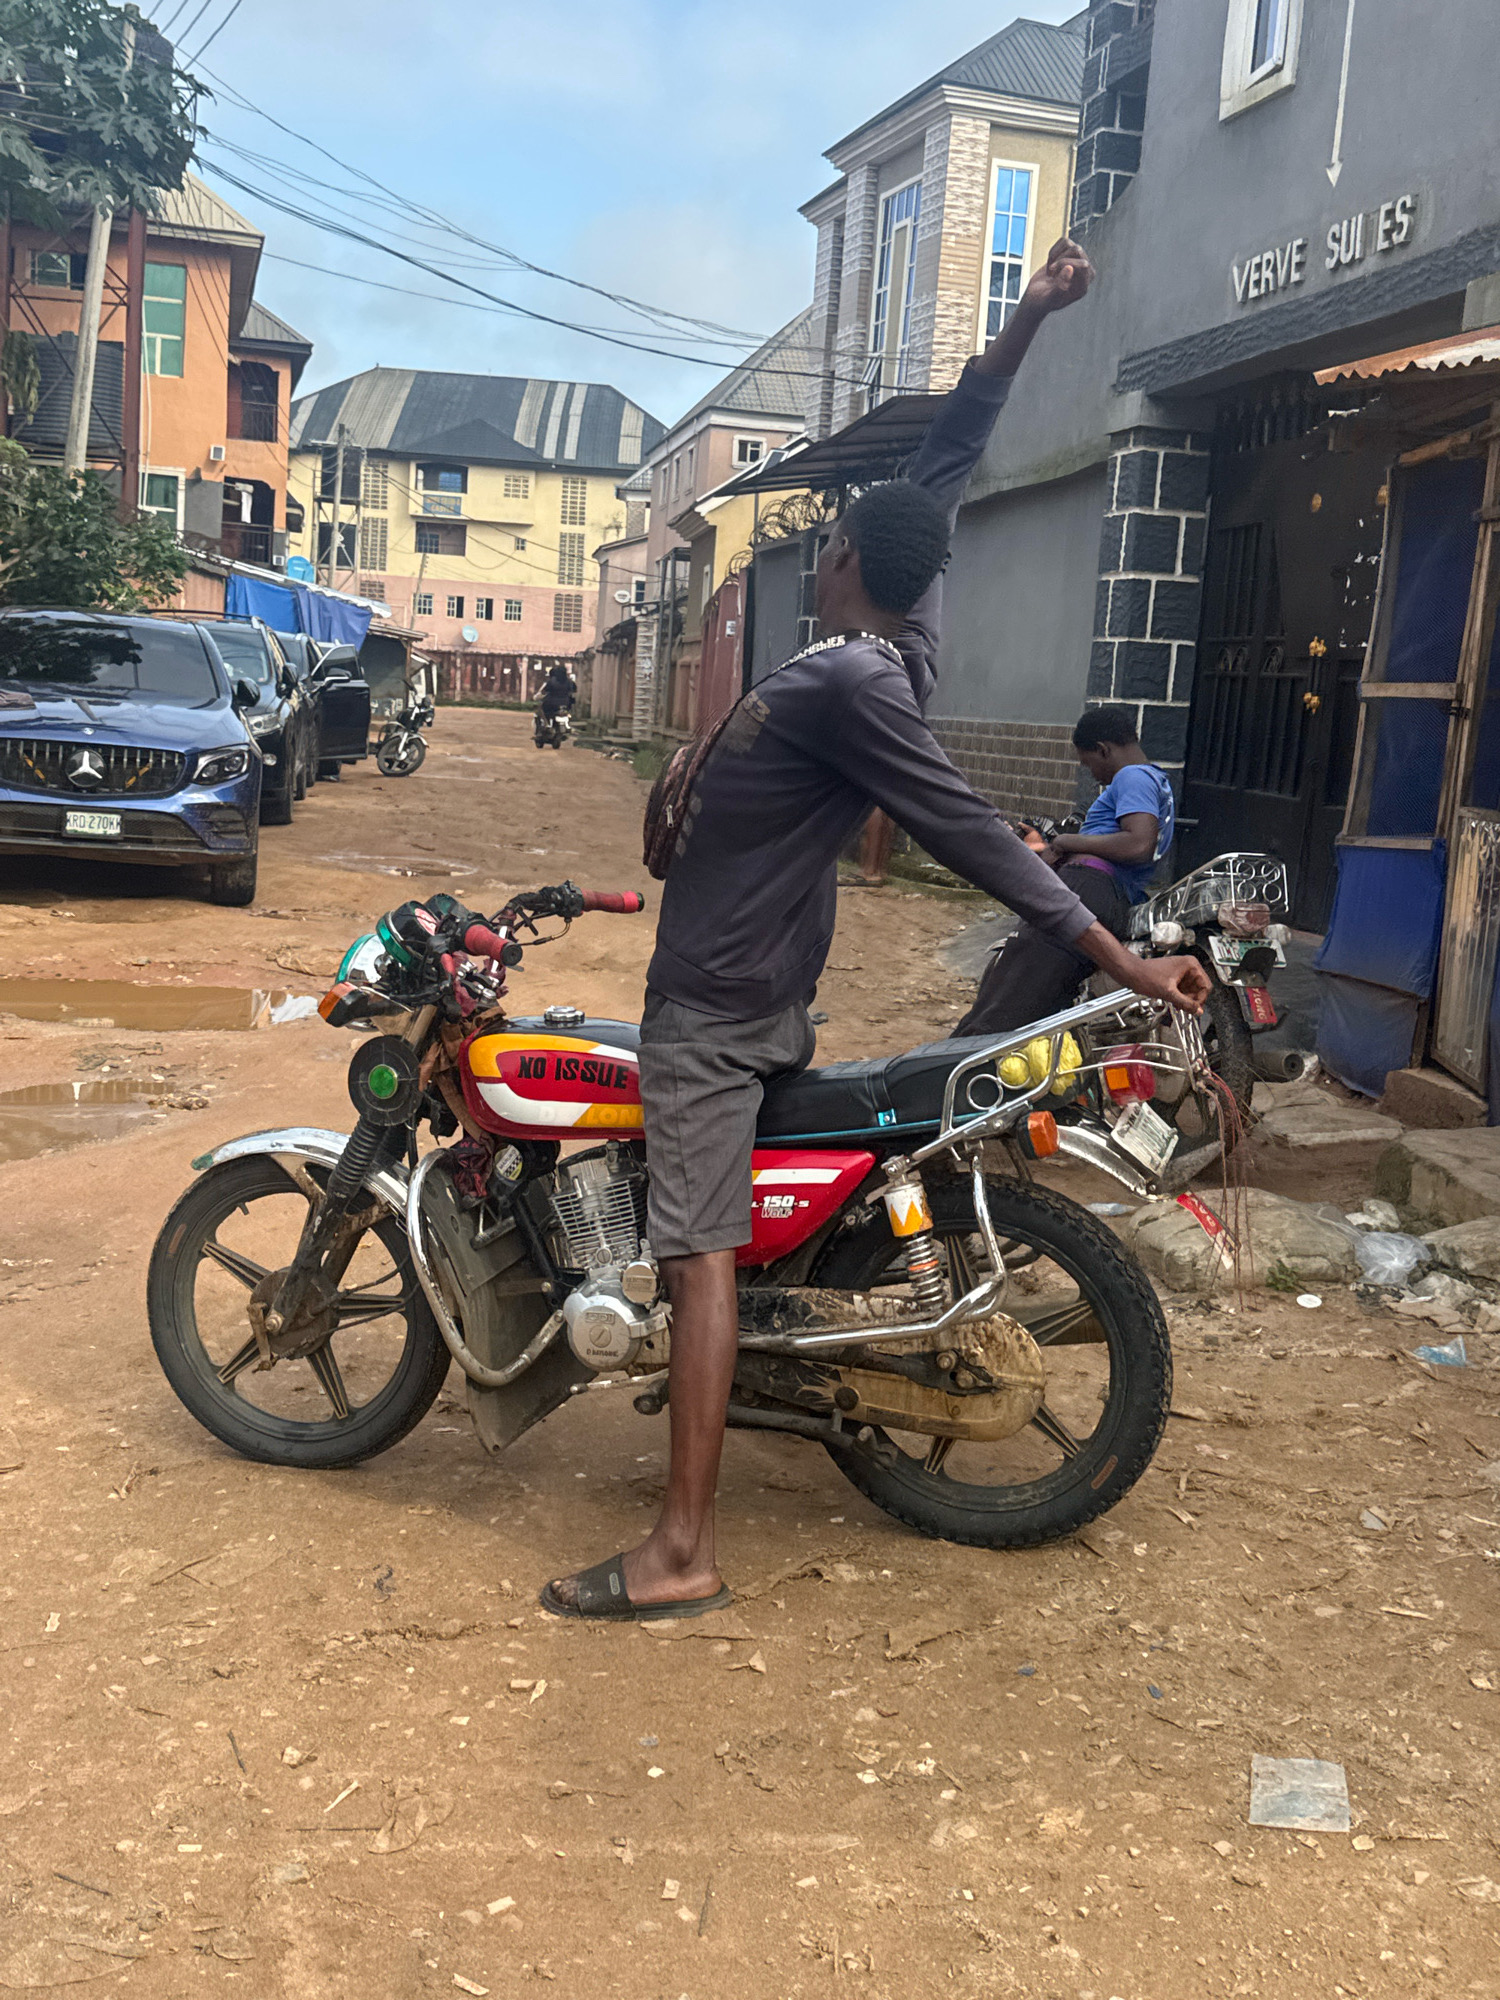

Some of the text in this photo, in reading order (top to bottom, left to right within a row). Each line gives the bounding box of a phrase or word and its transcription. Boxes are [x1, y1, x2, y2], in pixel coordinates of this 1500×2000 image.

[1232, 194, 1414, 303] VERVE SUIES
[518, 1056, 630, 1090] NO ISSUE
